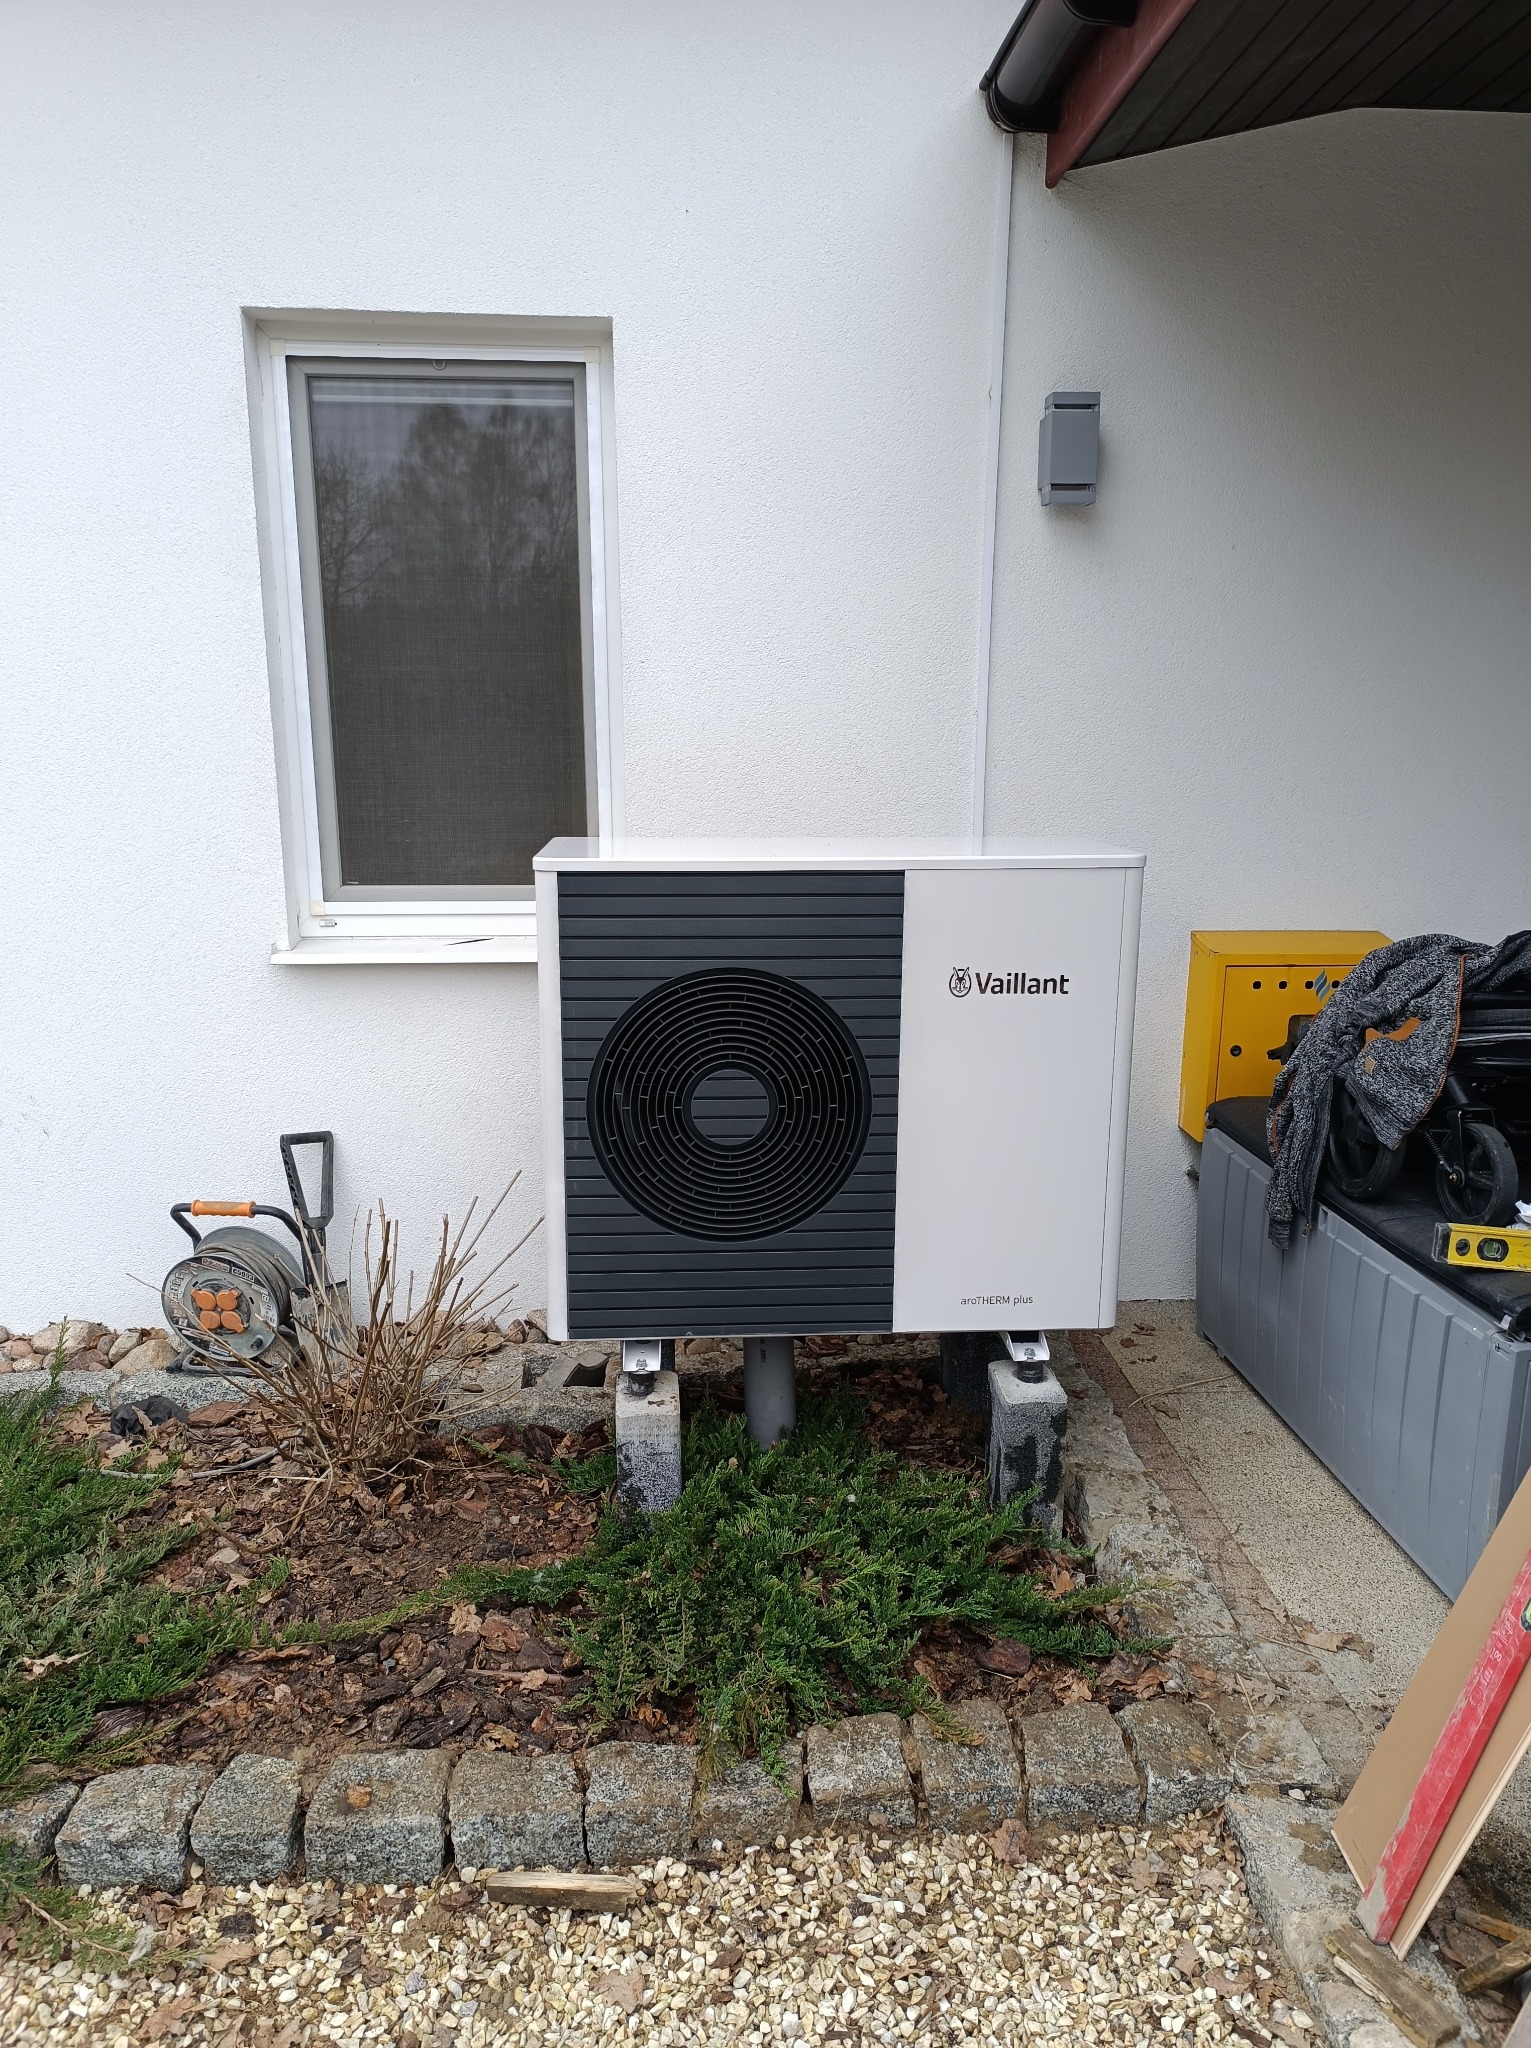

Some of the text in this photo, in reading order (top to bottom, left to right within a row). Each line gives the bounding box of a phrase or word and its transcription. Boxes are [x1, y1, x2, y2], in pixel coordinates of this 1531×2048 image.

[975, 972, 1070, 995] Vaillant
[960, 1294, 1034, 1306] aroTHERM plus
